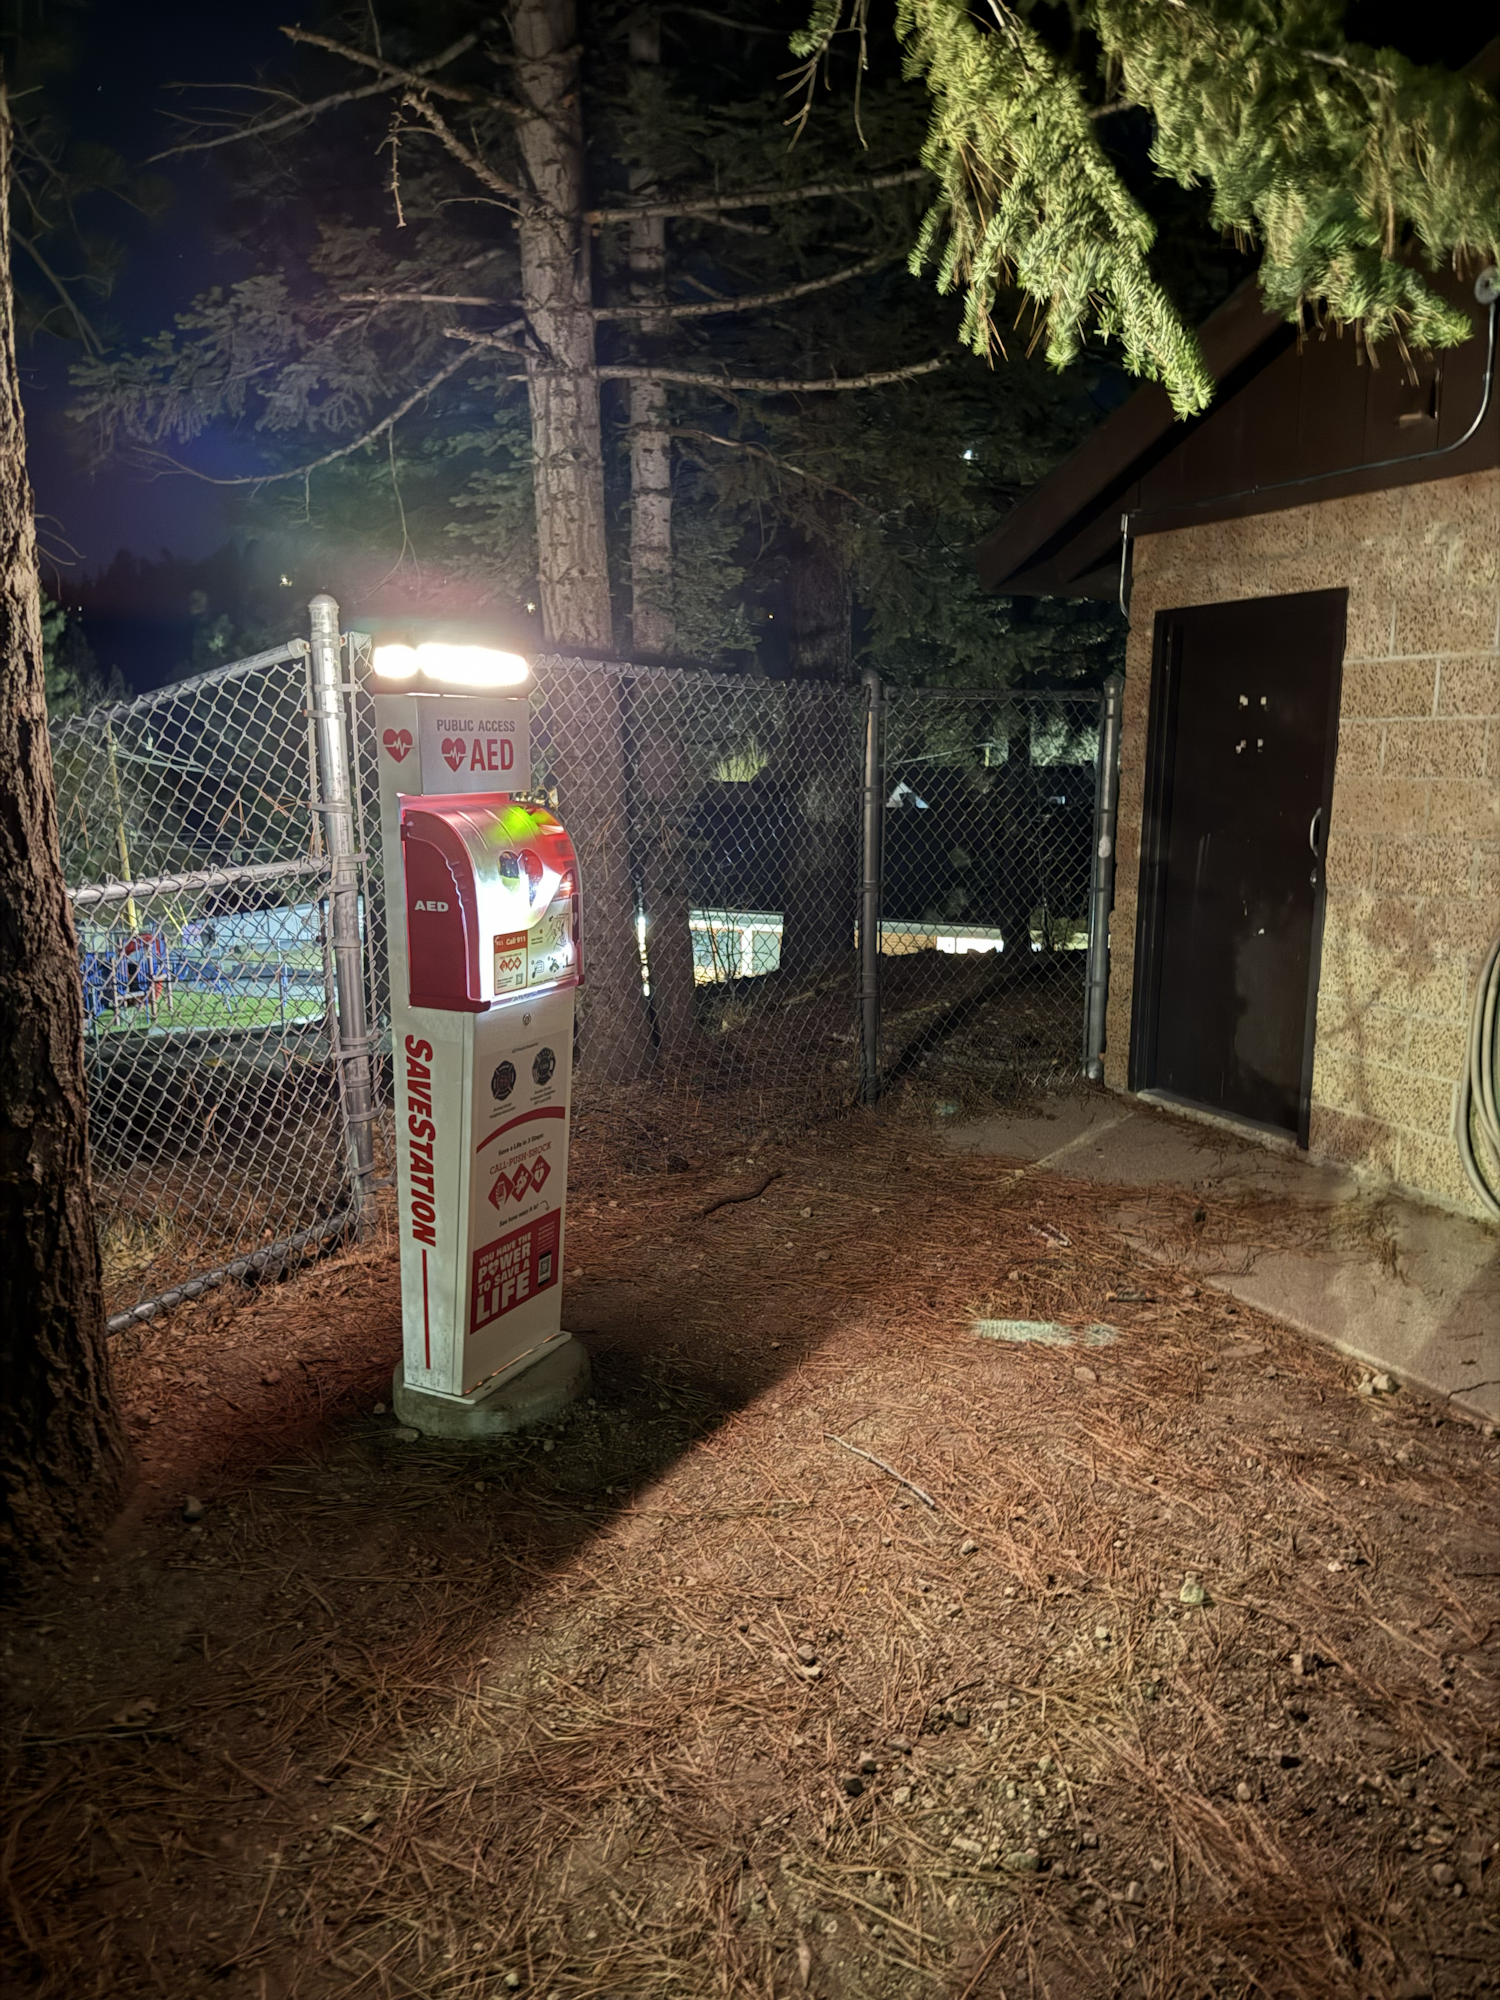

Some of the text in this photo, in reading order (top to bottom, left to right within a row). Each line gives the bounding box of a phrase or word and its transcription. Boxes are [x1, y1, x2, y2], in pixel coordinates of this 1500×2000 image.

[437, 719, 515, 732] PUBLIC ACCESS
[470, 738, 514, 771] AED
[414, 899, 449, 912] AED
[506, 937, 516, 946] Call
[517, 935, 526, 944] 911
[405, 1034, 437, 1248] SAVESTATION
[498, 1147, 510, 1157] Save
[479, 1251, 495, 1266] YOU
[496, 1239, 517, 1257] HAVE
[517, 1231, 532, 1244] THE
[478, 1257, 531, 1295] TO SAVE A
[476, 1269, 530, 1325] LIFE
